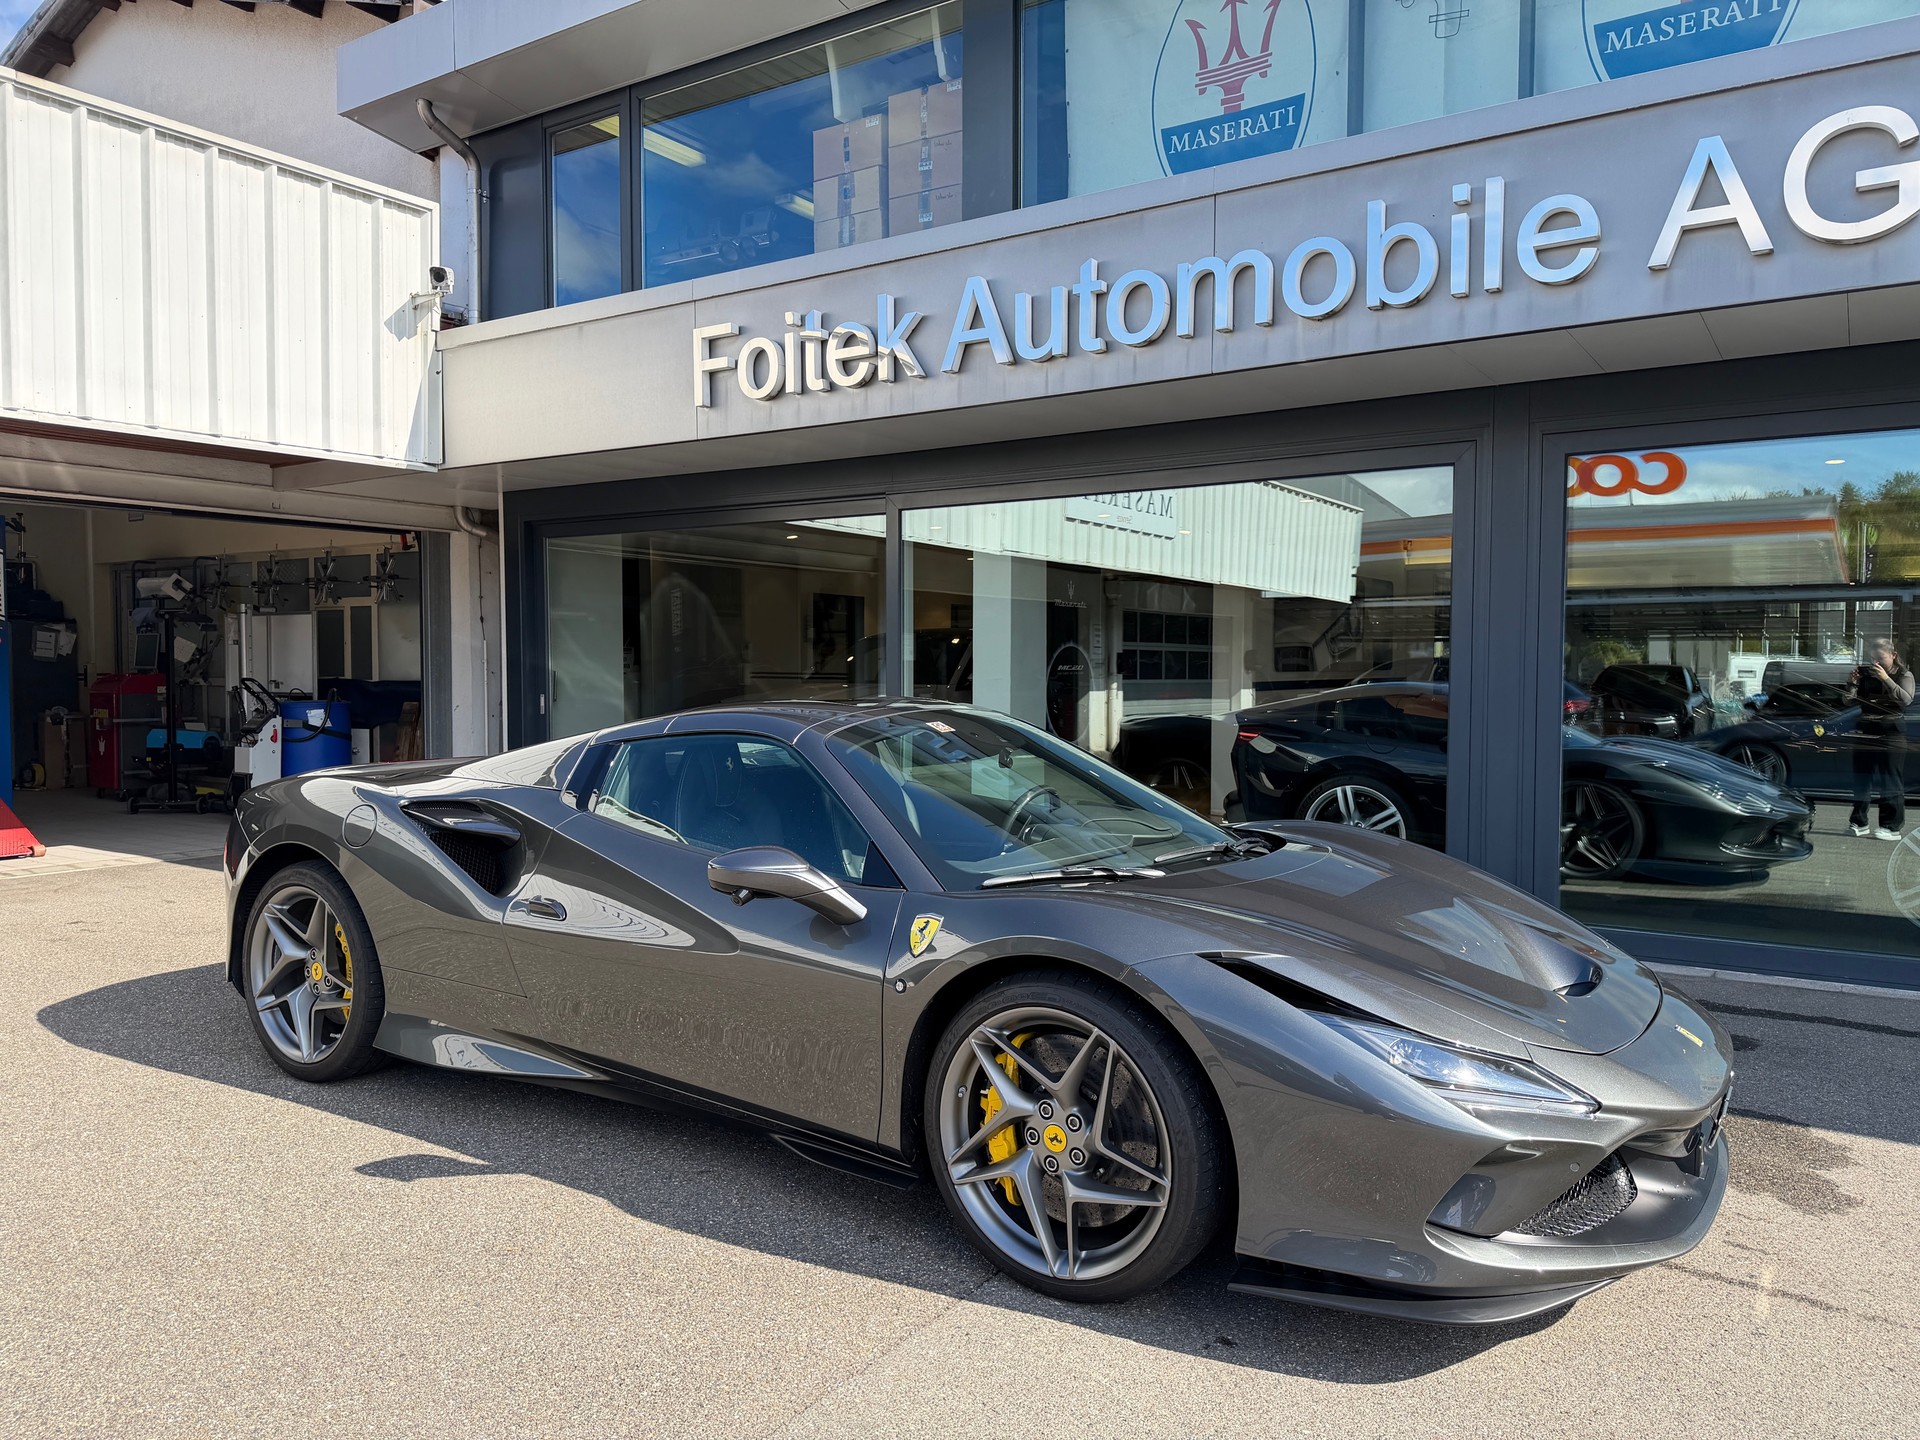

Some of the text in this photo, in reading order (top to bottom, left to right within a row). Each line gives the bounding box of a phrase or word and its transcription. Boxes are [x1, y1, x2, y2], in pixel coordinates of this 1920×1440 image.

[1169, 105, 1296, 154] MASERATI
[692, 105, 1920, 409] Foitek Automobile AG
